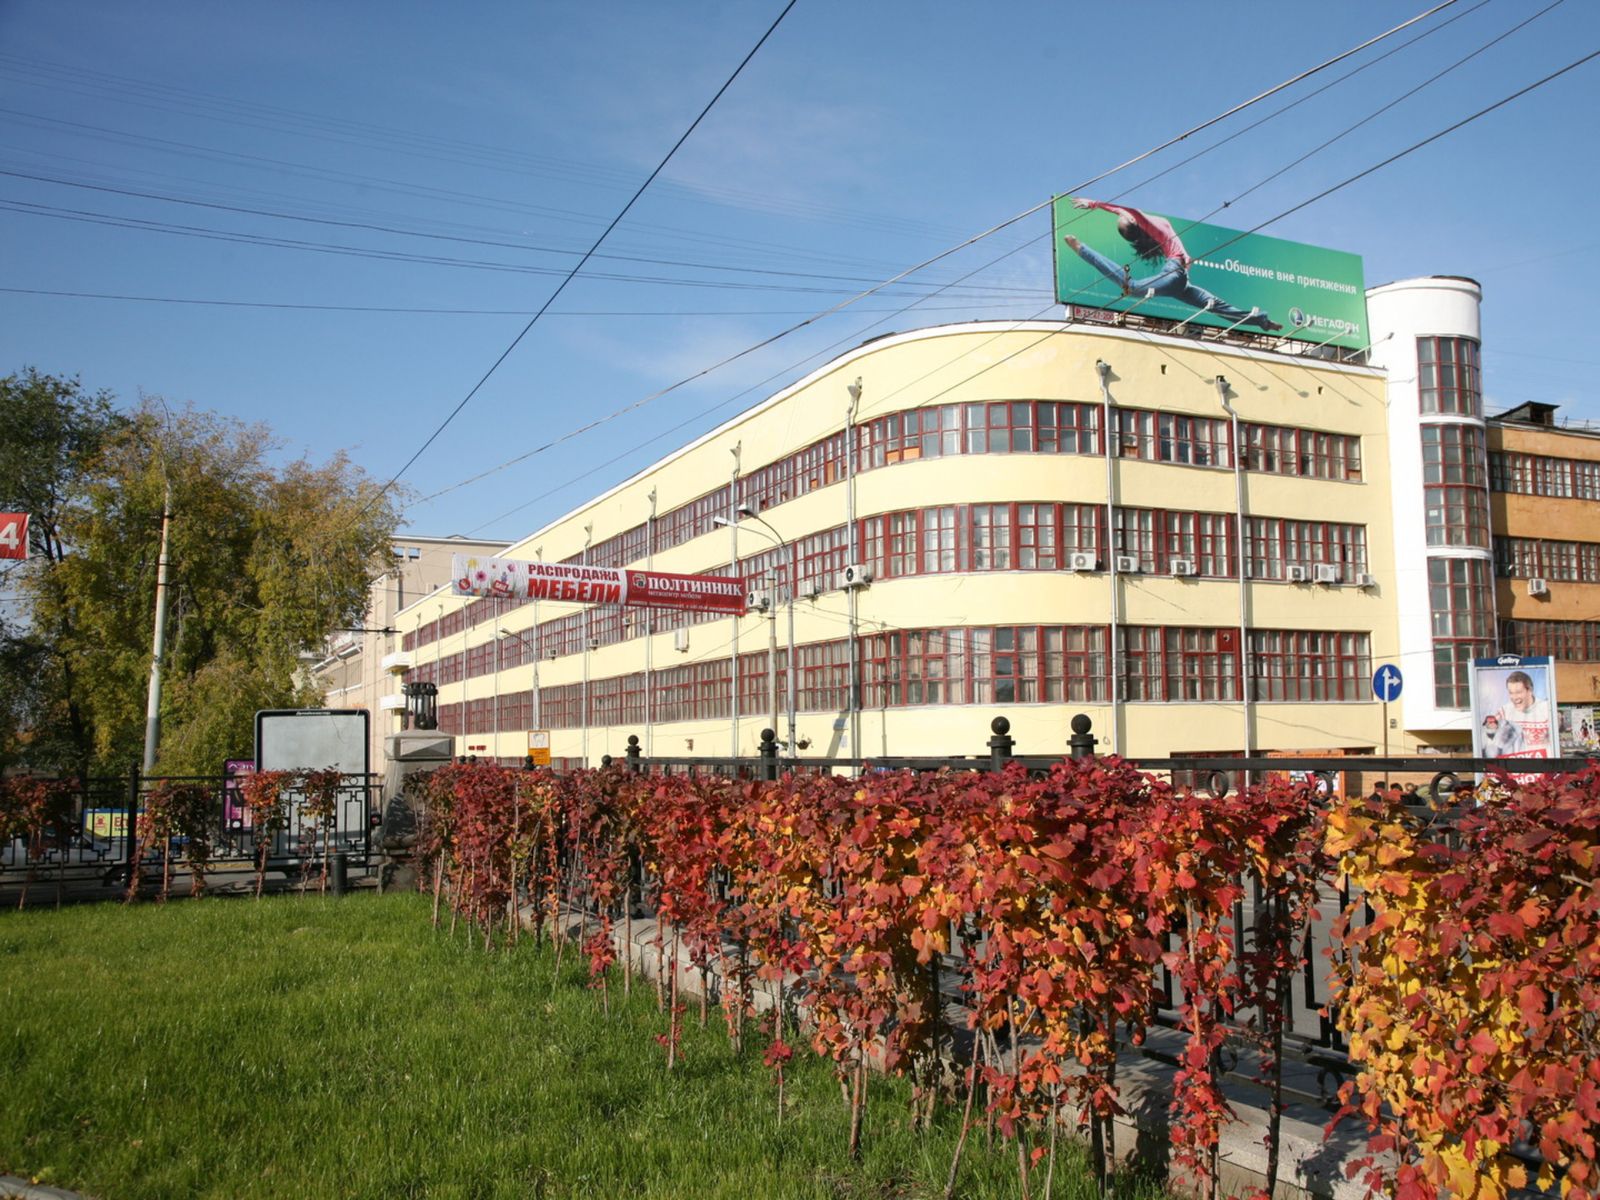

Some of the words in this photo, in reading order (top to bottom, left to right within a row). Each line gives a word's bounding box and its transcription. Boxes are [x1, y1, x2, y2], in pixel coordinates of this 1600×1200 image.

[1276, 270, 1295, 283] вне
[1297, 275, 1357, 294] притяжения
[0, 522, 20, 550] 4
[528, 563, 620, 582] РАСПРОДАЖА
[527, 577, 621, 604] МЕБЕЛИ
[647, 577, 743, 597] ПОЛТИННИК
